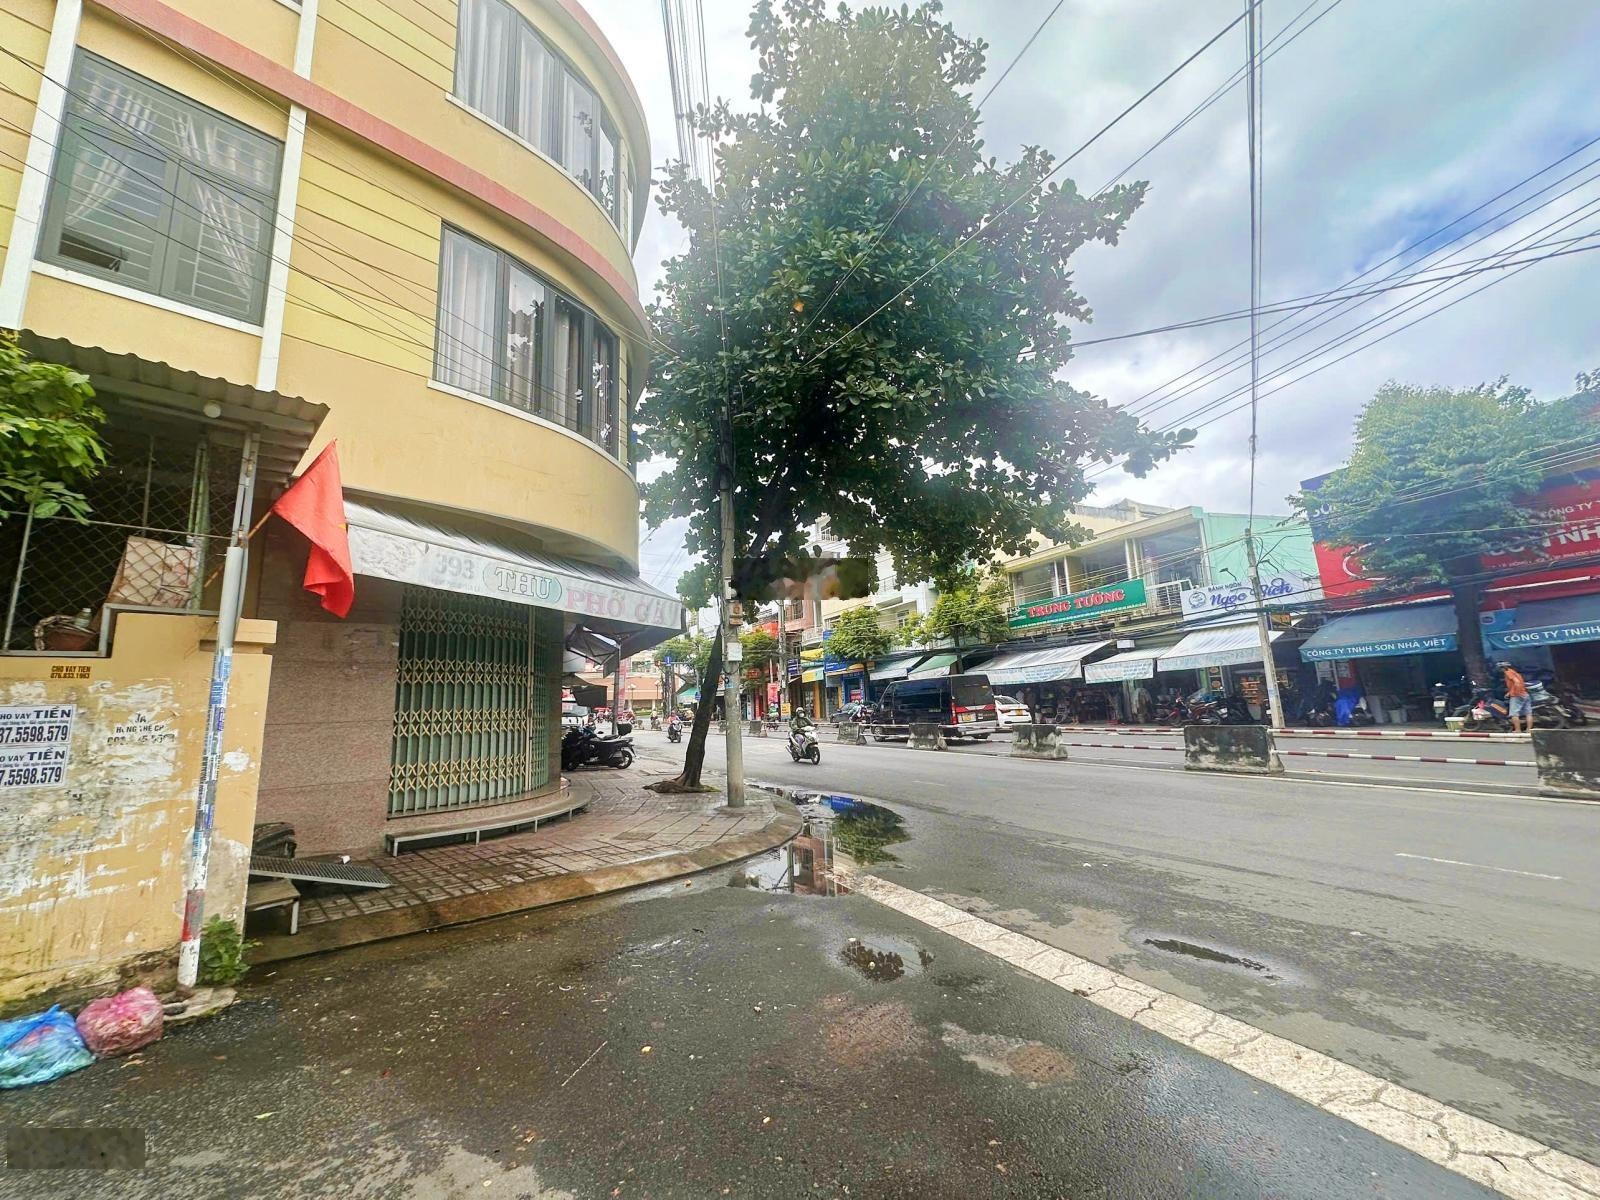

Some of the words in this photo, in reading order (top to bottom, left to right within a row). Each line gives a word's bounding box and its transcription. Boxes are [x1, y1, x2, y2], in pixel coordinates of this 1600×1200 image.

[1576, 501, 1592, 511] TY
[495, 566, 553, 600] THU
[1027, 600, 1072, 618] TRUNG
[1503, 632, 1540, 643] CÔNG
[1542, 630, 1558, 639] TY
[1561, 625, 1600, 637] TNHH
[1306, 648, 1331, 657] CÔNG
[1346, 645, 1372, 654] TNHH
